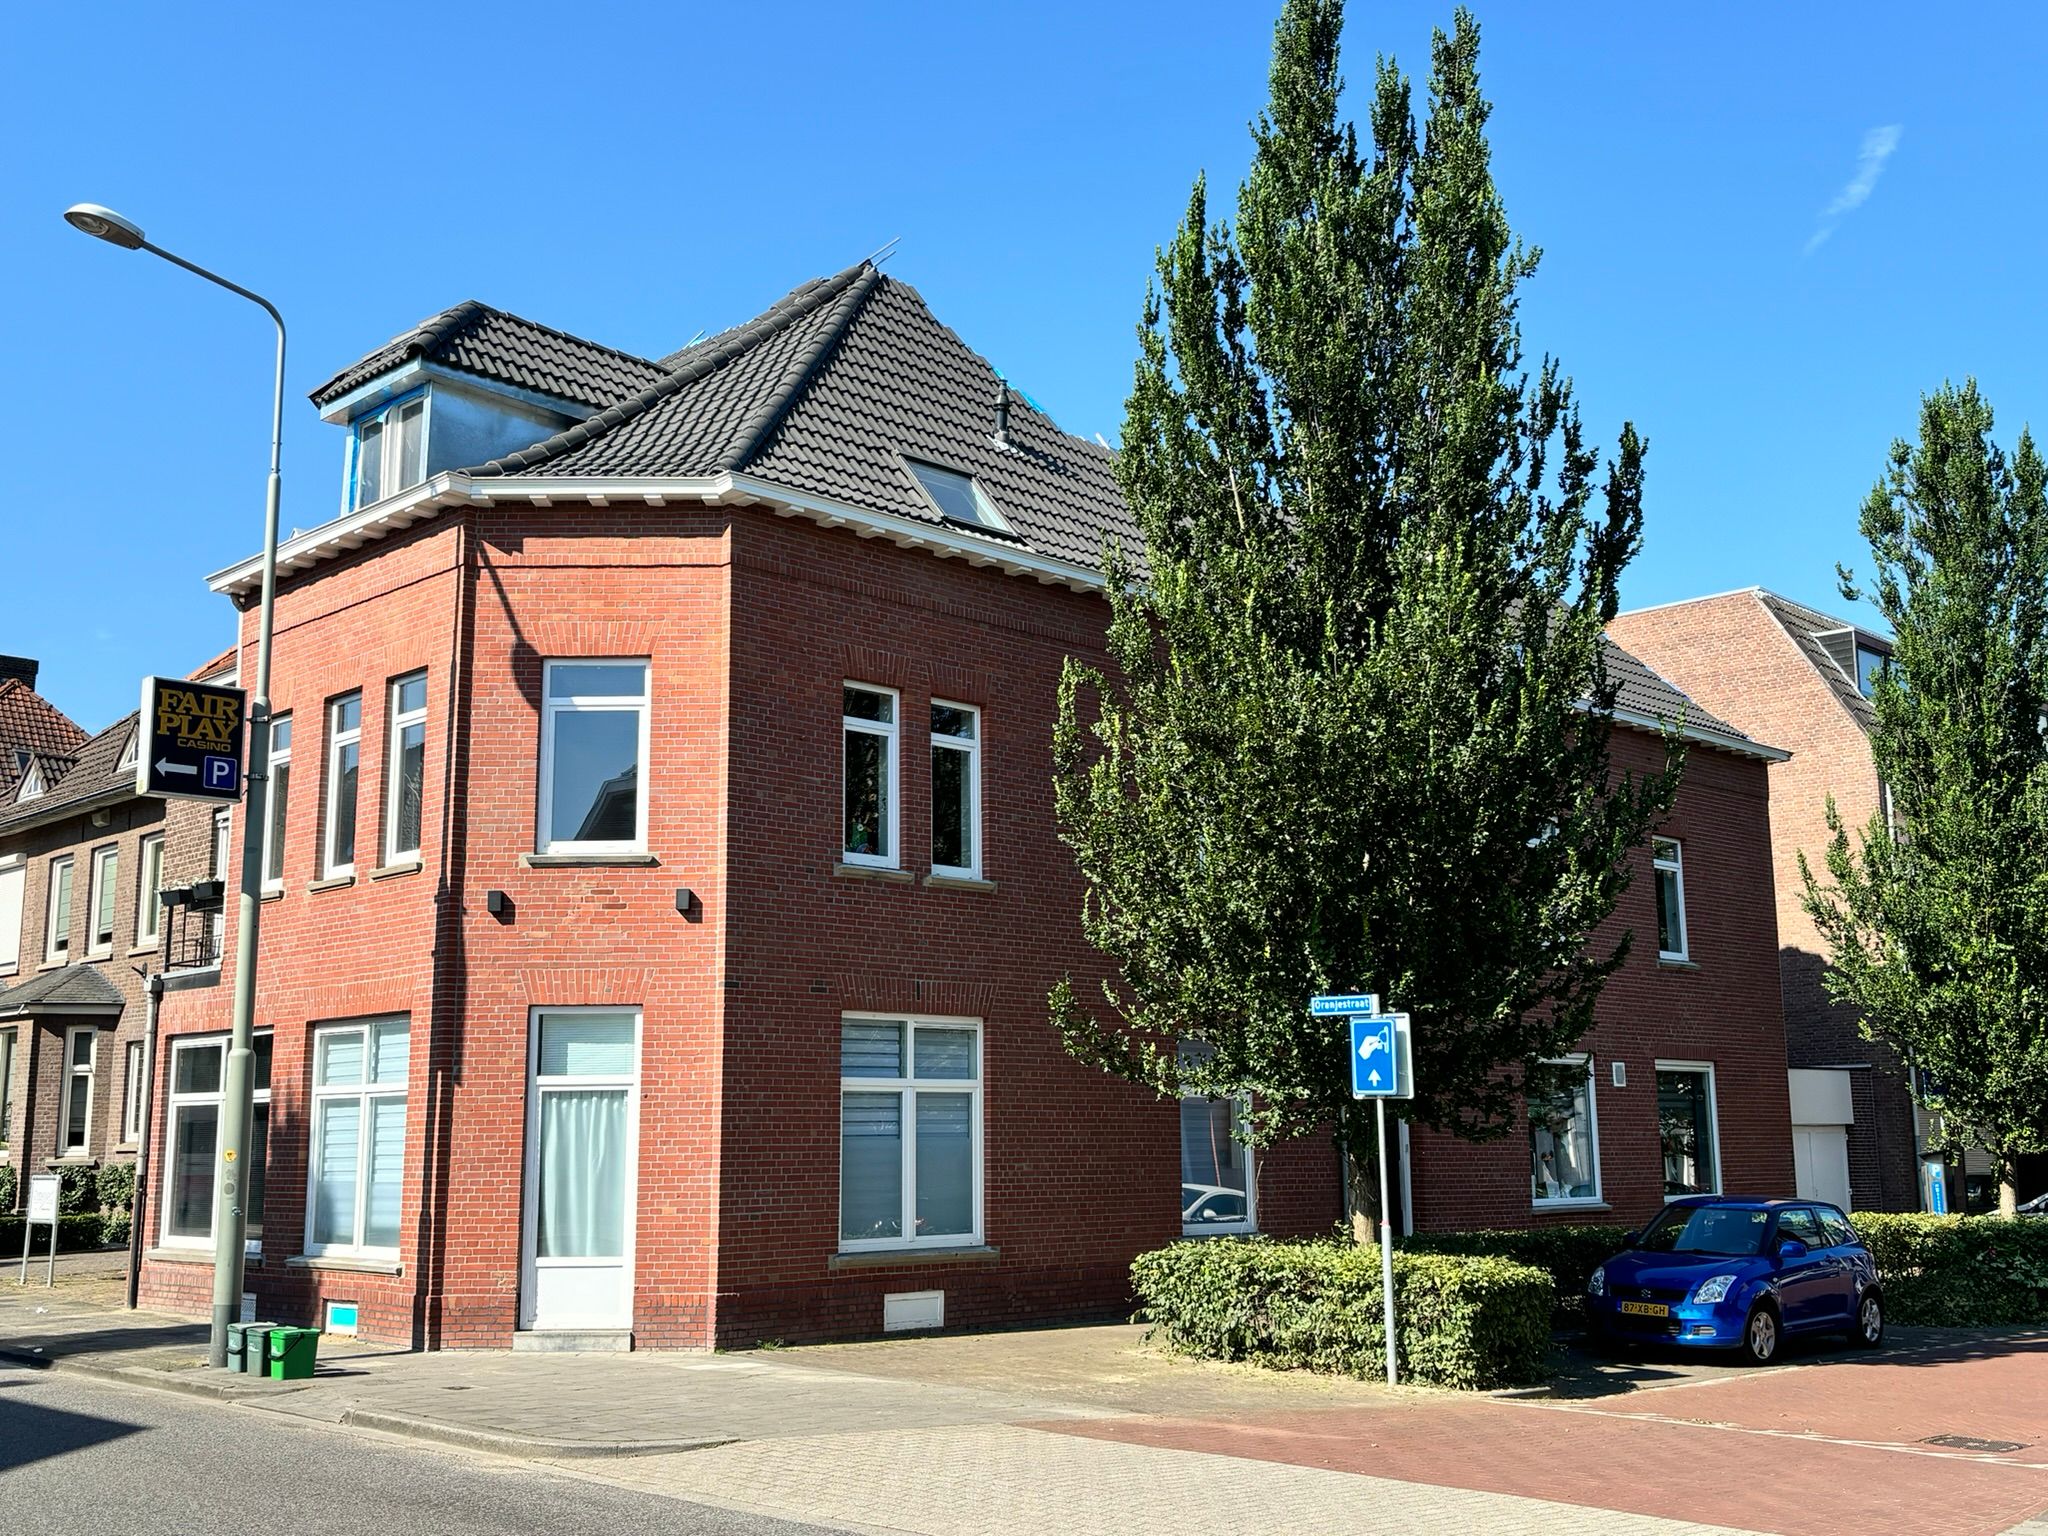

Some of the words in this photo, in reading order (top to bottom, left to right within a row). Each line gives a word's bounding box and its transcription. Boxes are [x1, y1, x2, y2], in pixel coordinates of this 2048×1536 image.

[160, 688, 239, 720] FAIR
[157, 707, 239, 743] PLAY
[177, 738, 231, 752] CASINO
[213, 761, 230, 785] P
[1314, 999, 1370, 1011] Oranjestraat
[1623, 1303, 1666, 1315] 87-XB-GH
